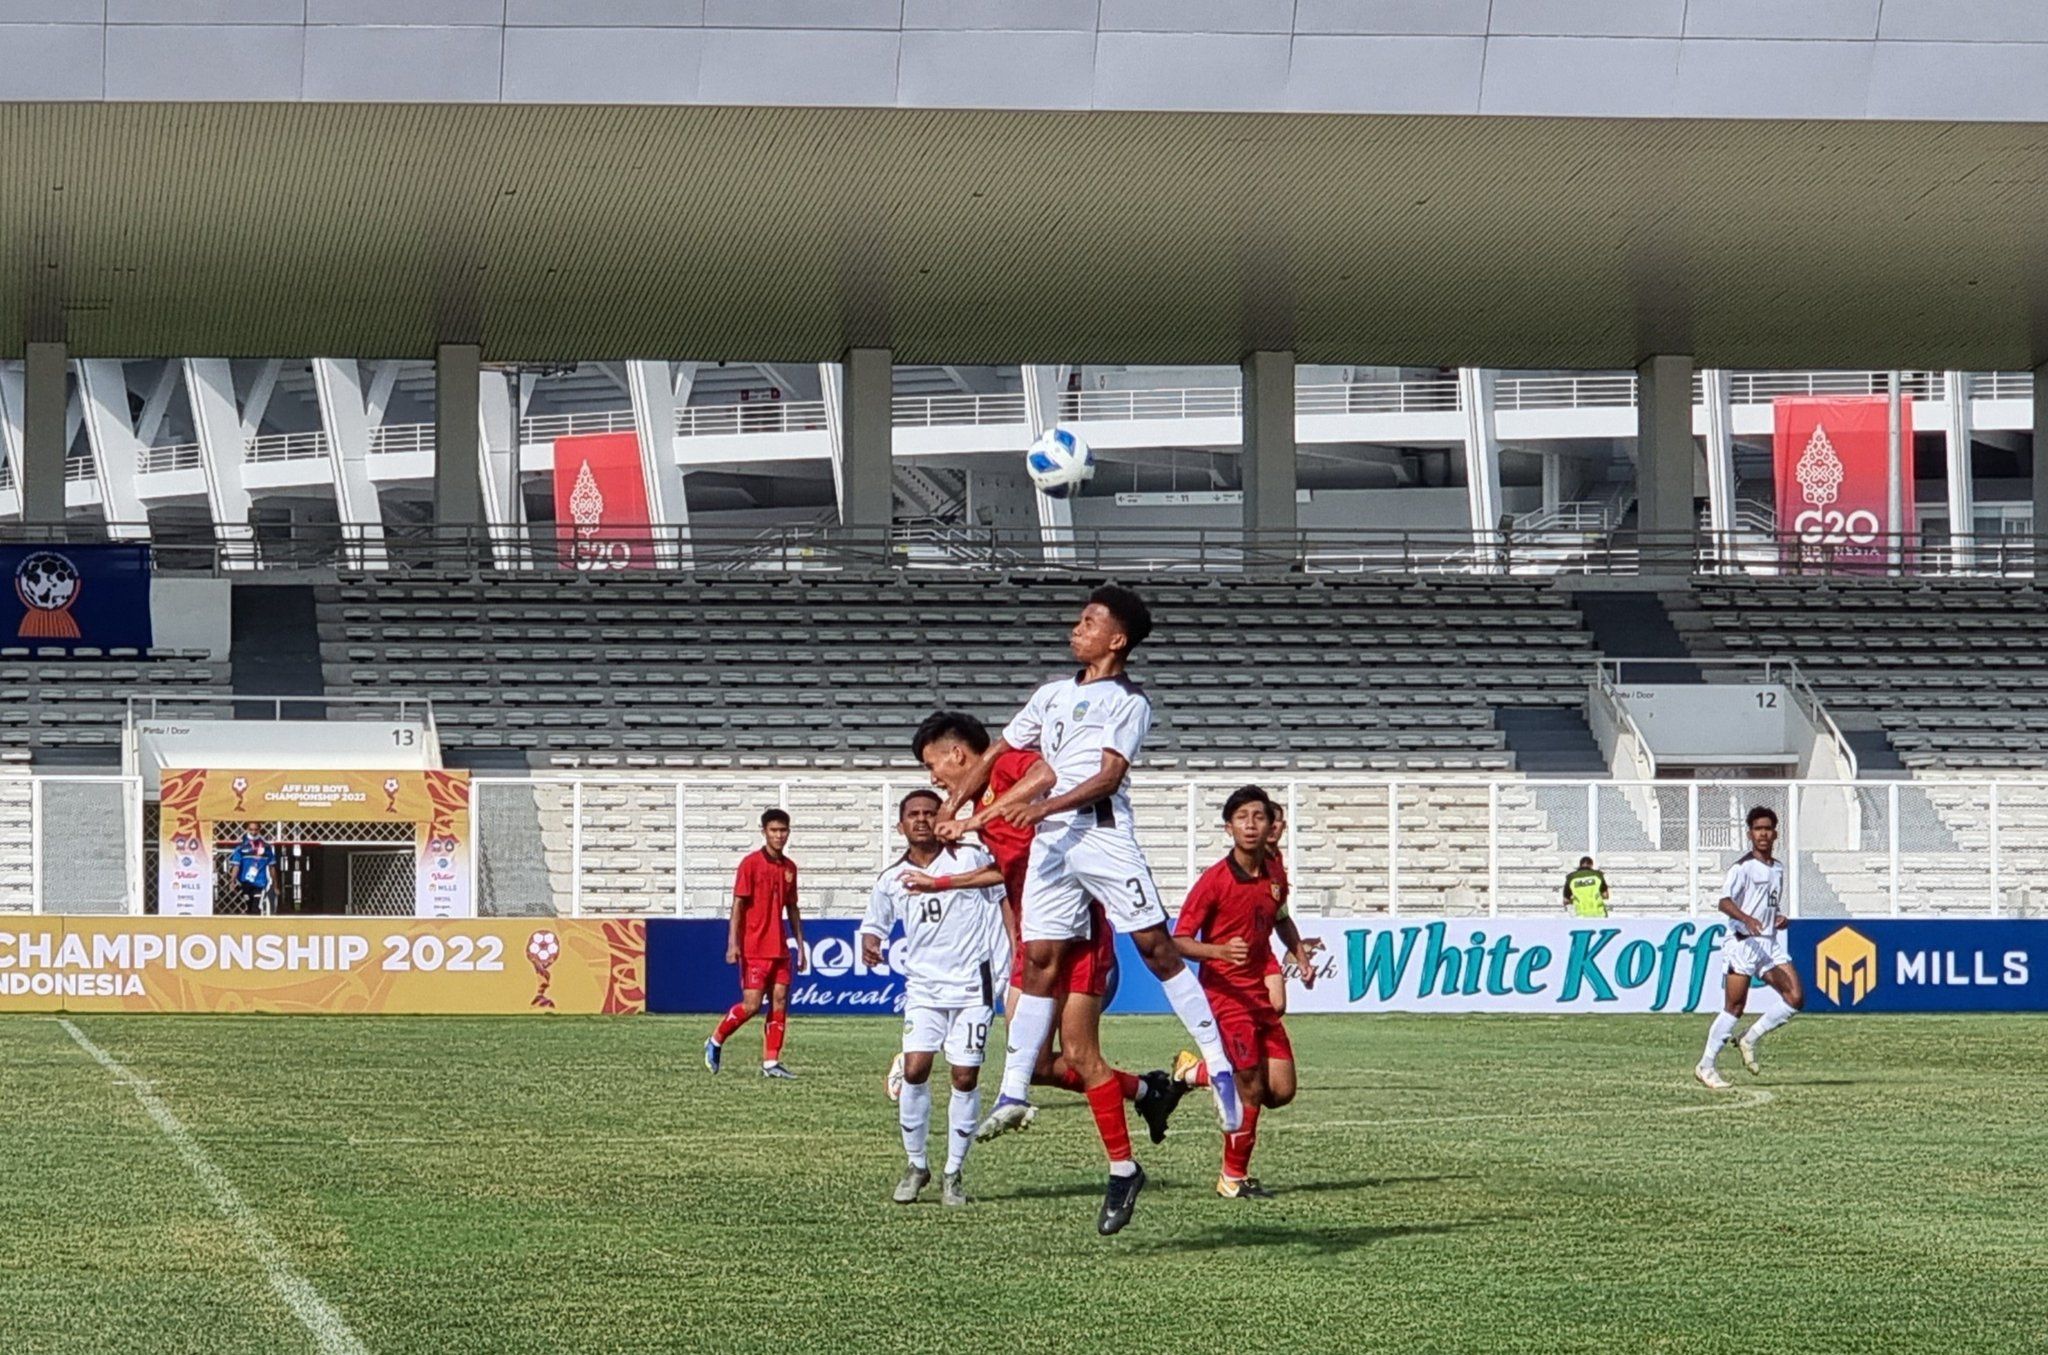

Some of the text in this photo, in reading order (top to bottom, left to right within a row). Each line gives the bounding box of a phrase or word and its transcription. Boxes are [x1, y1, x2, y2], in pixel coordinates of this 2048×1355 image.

[1794, 510, 1879, 544] G20
[1636, 691, 1654, 699] Door
[1756, 692, 1777, 708] 12
[171, 726, 190, 735] Door
[391, 729, 414, 746] 13
[1052, 721, 1065, 752] 3
[264, 792, 340, 802] CHAMPIONSHIP
[282, 784, 302, 793] AFF
[322, 784, 350, 793] BOYS
[1126, 877, 1147, 909] 3
[920, 898, 942, 923] 19
[382, 935, 504, 971] 2022
[1344, 921, 1766, 1013] White Koff
[1896, 951, 2029, 985] MILLS
[791, 983, 835, 1005] the
[836, 983, 895, 1005] real
[966, 1023, 987, 1049] 19
